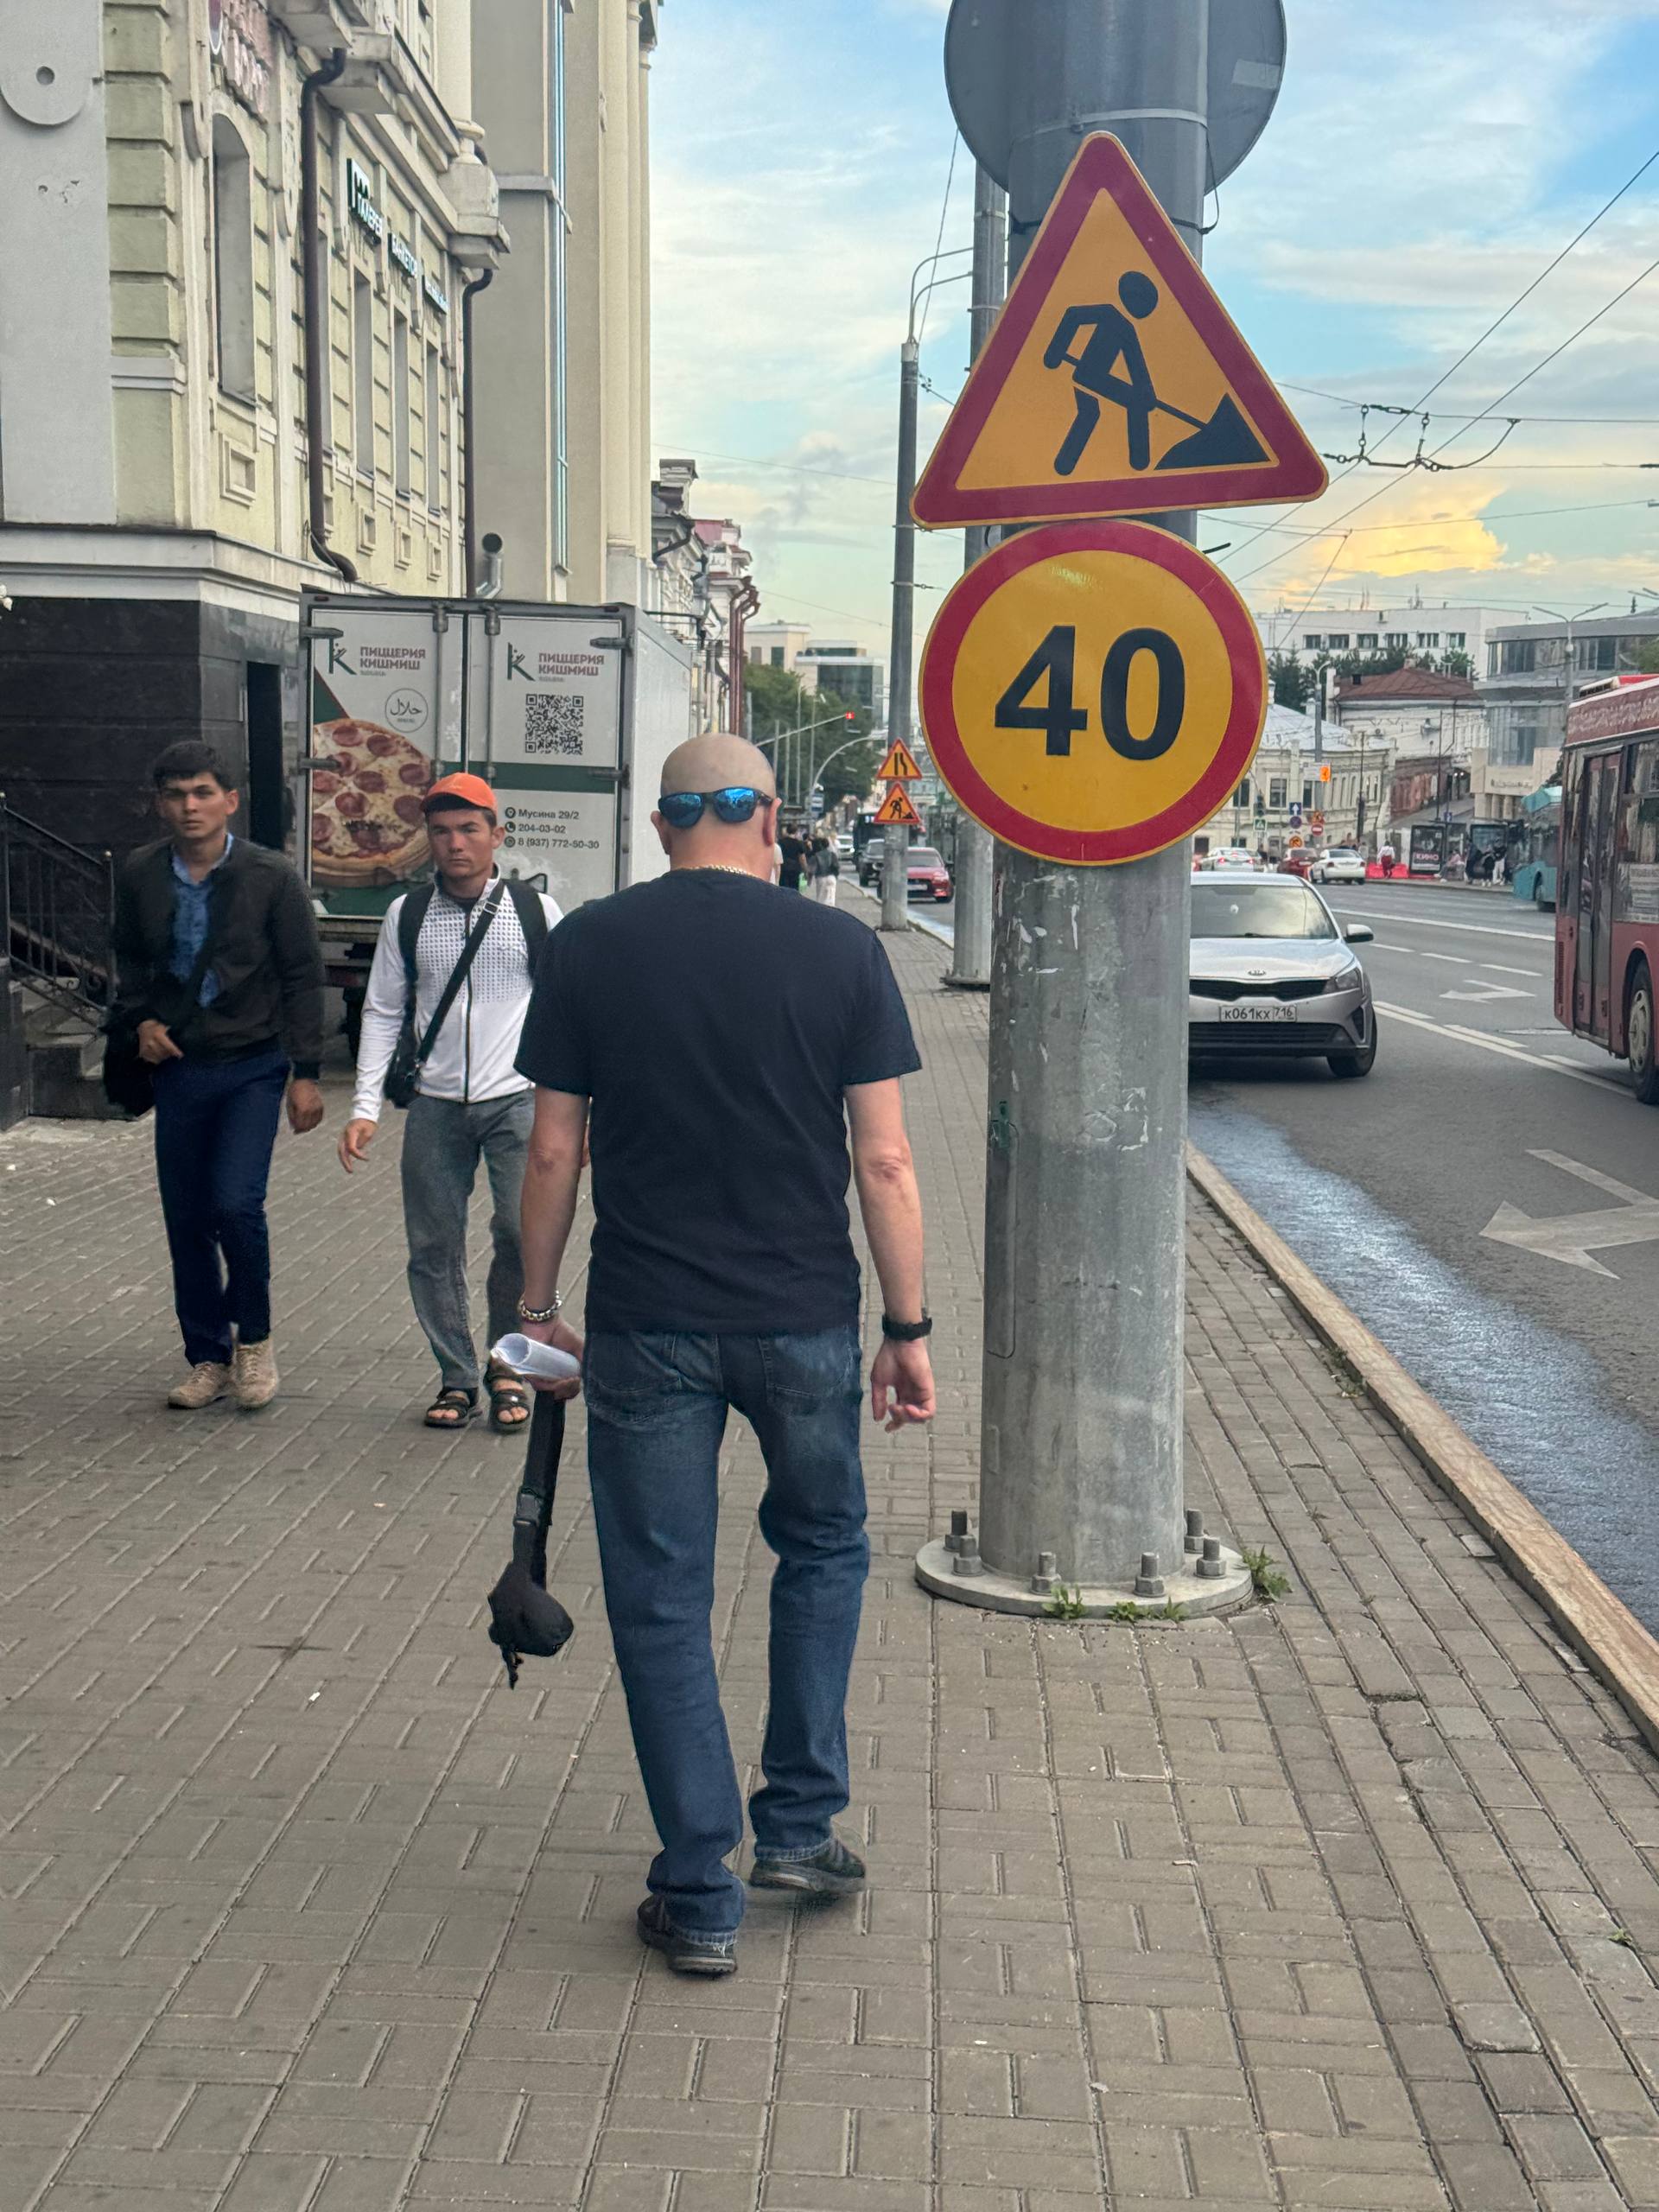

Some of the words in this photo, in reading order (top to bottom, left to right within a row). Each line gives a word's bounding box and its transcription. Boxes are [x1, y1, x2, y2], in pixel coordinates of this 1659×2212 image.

[360, 646, 426, 659] ПИЦЦЕРИЯ
[538, 652, 605, 665] ПИЦЦЕРИЯ
[359, 658, 421, 671] КИШМИШ
[538, 664, 599, 677] КИШМИШ
[995, 625, 1185, 761] 40
[390, 697, 422, 716] حلال
[518, 809, 556, 819] Мусина
[558, 810, 580, 820] 29/2
[518, 823, 566, 834] 204-03-02
[518, 837, 524, 846] 8
[526, 837, 550, 849] (937)
[1274, 1007, 1294, 1017] 716
